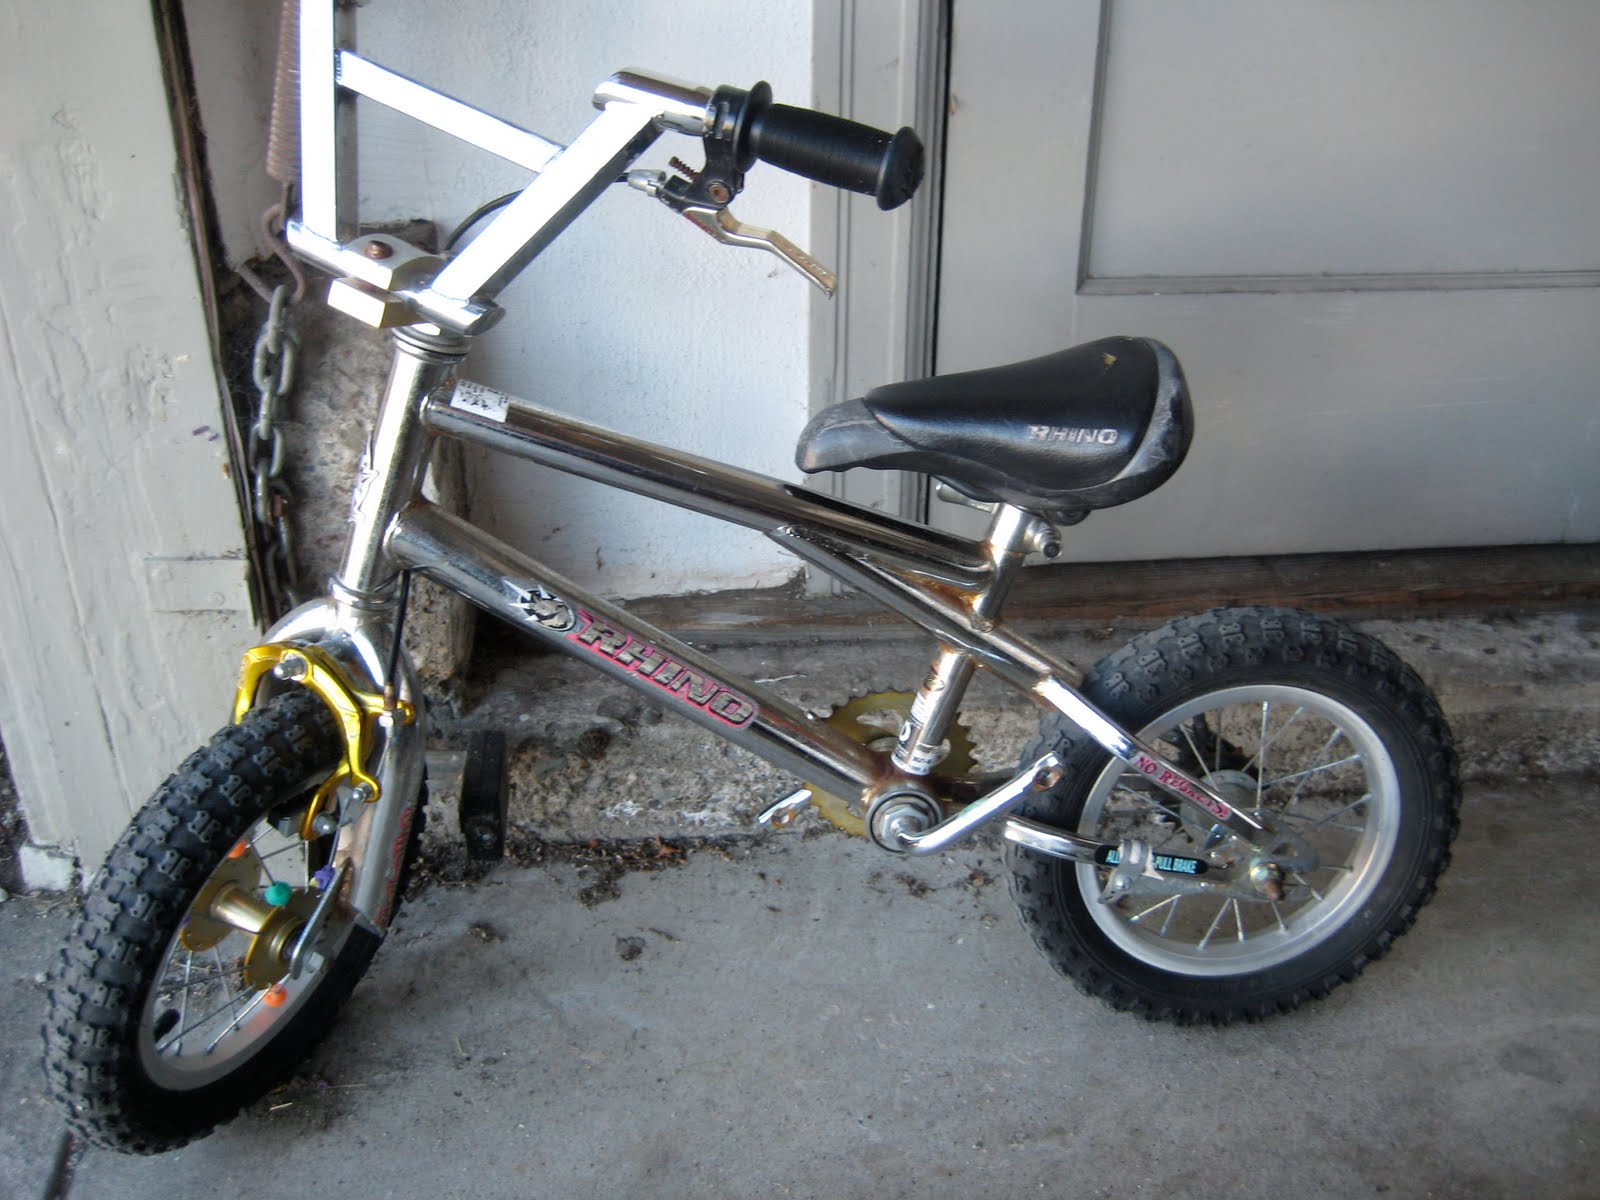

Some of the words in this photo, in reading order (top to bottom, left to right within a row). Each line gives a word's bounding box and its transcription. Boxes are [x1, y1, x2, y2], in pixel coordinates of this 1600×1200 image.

[1027, 424, 1118, 444] RHINO
[572, 612, 755, 728] RHINO
[1134, 756, 1158, 775] NO
